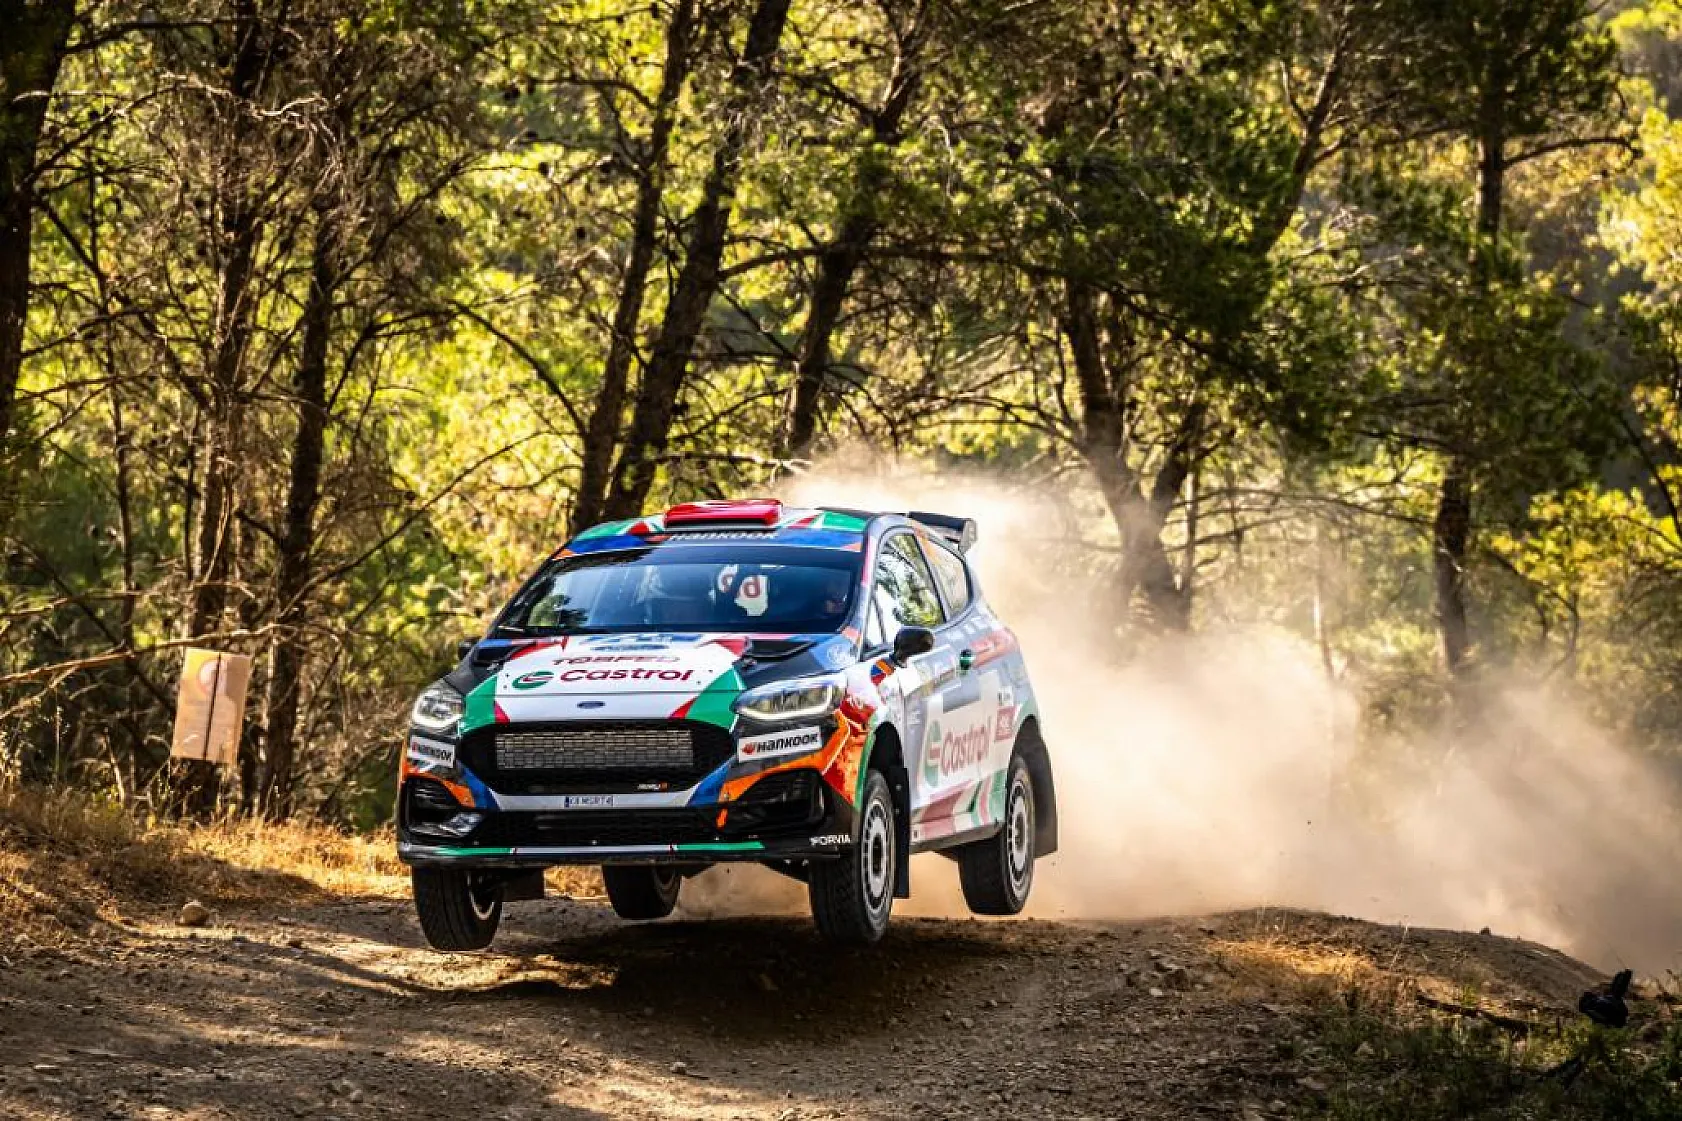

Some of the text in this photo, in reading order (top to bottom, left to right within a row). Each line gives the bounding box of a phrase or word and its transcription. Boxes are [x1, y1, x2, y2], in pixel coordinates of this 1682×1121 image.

[560, 668, 695, 682] Castrol
[941, 715, 991, 777] Castrol
[810, 834, 851, 847] FORVIA
